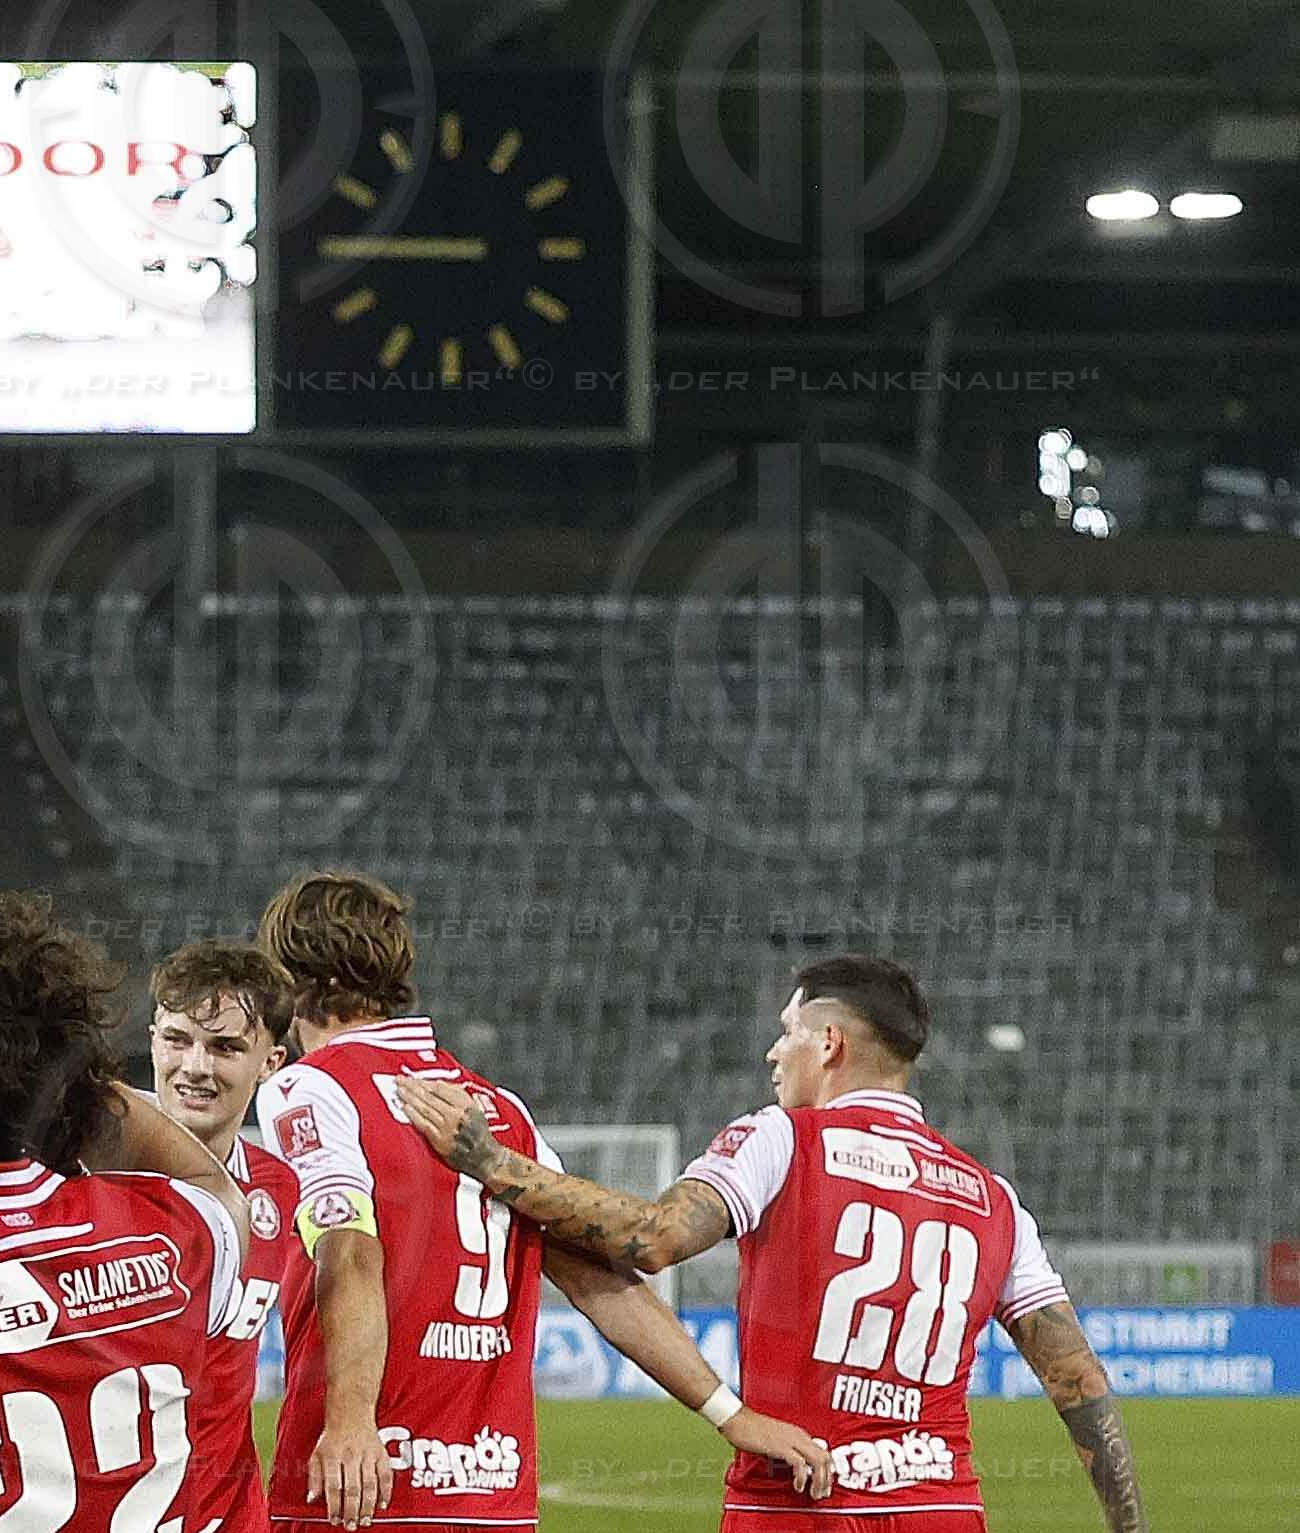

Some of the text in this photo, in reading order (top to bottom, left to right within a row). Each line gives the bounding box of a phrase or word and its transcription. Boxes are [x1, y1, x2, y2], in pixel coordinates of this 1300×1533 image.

[454, 1173, 510, 1320] 9
[812, 1201, 980, 1387] 28
[832, 1375, 923, 1422] FRIESER
[411, 1468, 453, 1489] SOFT
